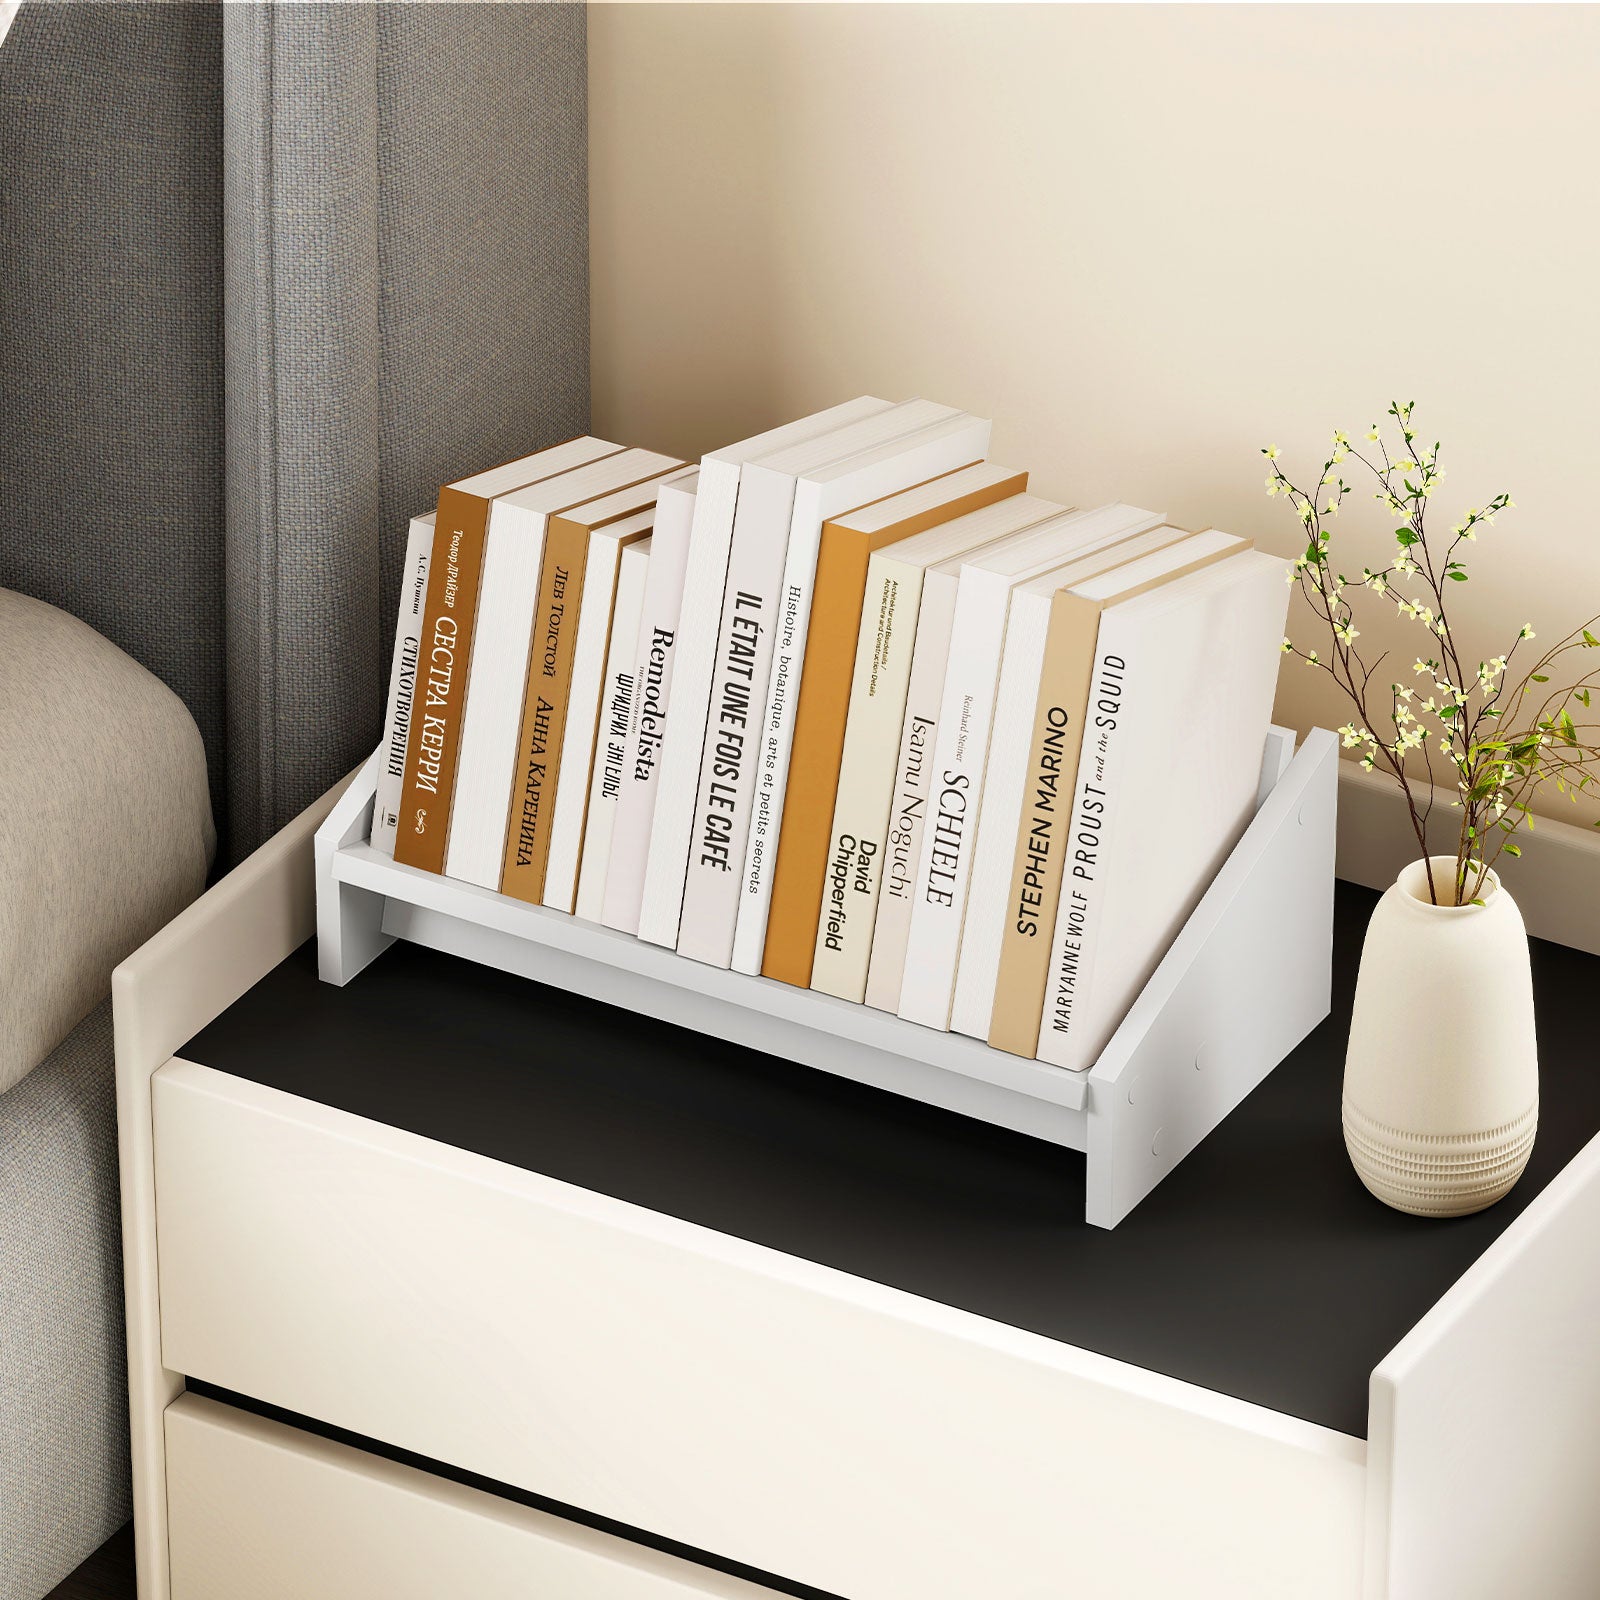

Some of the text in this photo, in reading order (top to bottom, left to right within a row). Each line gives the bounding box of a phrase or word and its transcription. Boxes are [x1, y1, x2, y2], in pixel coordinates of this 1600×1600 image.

[413, 577, 425, 615] Пушкин
[444, 530, 464, 608] Теодор ДРАЙЗЕР
[543, 566, 569, 678] ЛЕВ ТОЛСТОЙ
[880, 578, 891, 619] Architecture
[886, 617, 894, 632] und
[888, 580, 899, 618] Architektur
[387, 636, 419, 778] СТИХОТВОРЕНИЯ
[415, 616, 458, 795] СЕСТРА КЕРРИ
[634, 625, 675, 782] Remodelista
[869, 674, 878, 697] Details
[872, 632, 884, 675] Construction
[881, 631, 892, 667] Baudetails
[516, 695, 554, 867] АННА КАРЕНИНА
[701, 591, 764, 872] IL ÉTAIT UNE FOIS LE CAFÉ
[749, 585, 801, 894] Histoire, botanique, arts et petits secrets
[956, 694, 974, 763] Reinhard Steiner
[1072, 655, 1126, 881] PROUST and the SQUID
[888, 715, 935, 899] Isamu Noguchi
[926, 770, 970, 908] SCHIELE
[1016, 706, 1069, 938] STEPHEN MARINO
[824, 834, 857, 952] Chipperfield
[853, 839, 878, 895] David
[1052, 890, 1088, 1033] MARYANNE WOLF
